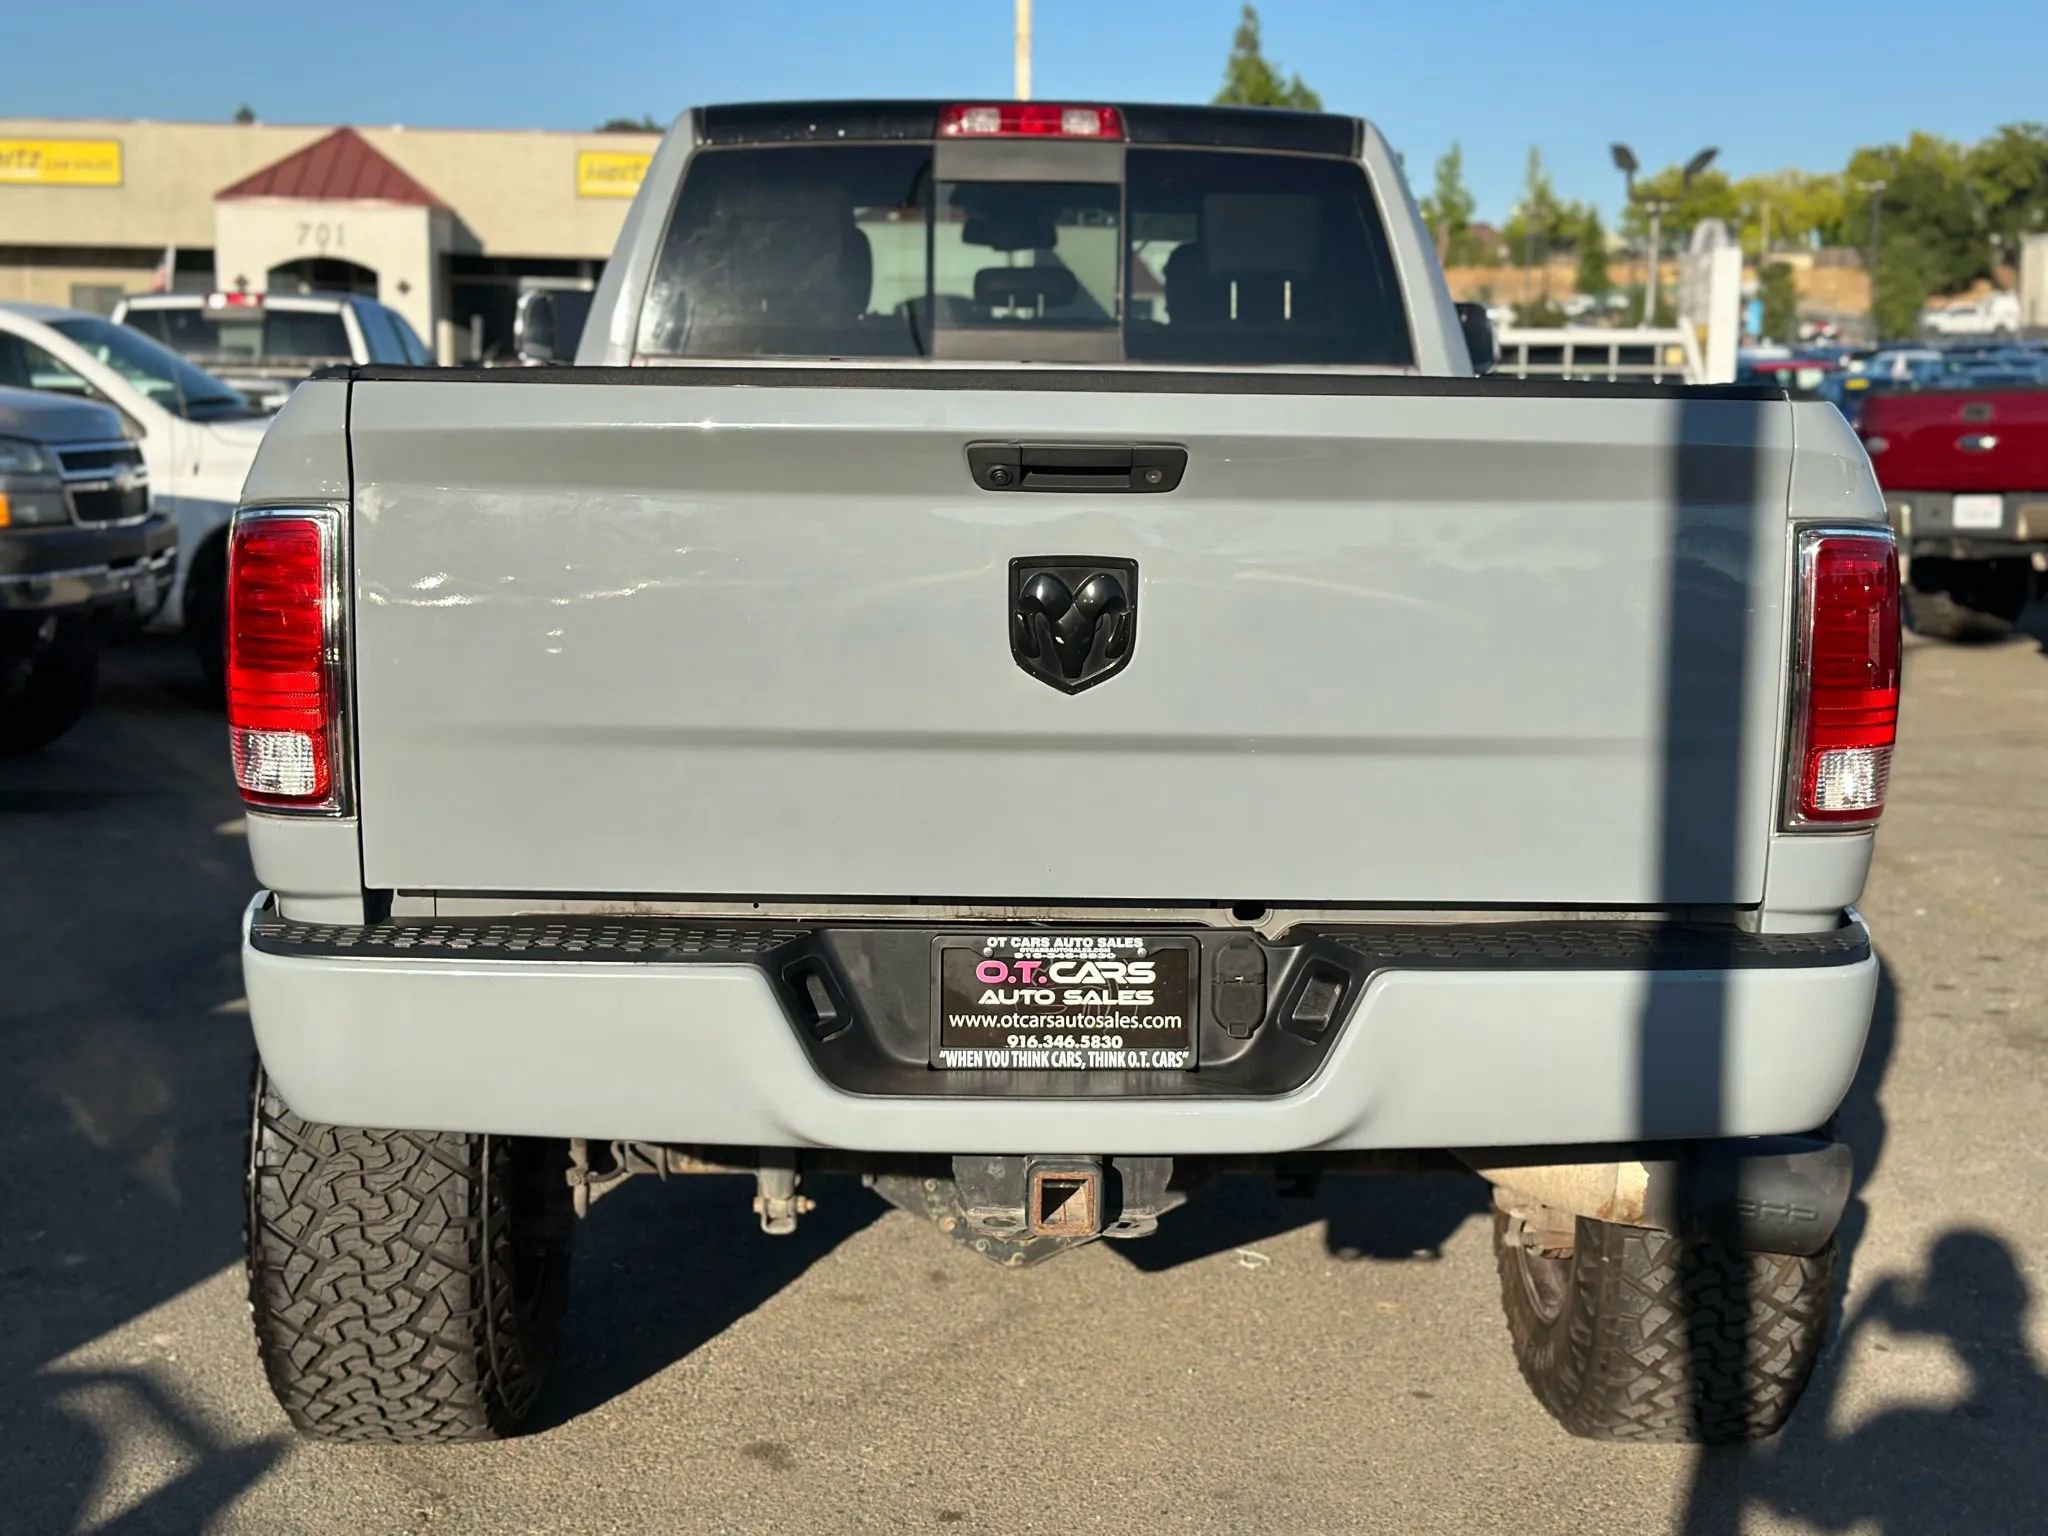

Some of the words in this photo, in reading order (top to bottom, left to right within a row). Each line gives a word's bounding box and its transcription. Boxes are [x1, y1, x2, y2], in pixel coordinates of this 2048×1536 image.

[586, 162, 647, 182] Hert
[296, 221, 345, 248] 701
[987, 937, 1007, 948] OT
[1010, 937, 1050, 948] CARS
[1053, 937, 1094, 948] AUTO
[1097, 937, 1144, 948] SALES
[977, 989, 1056, 1005] AUTO
[1062, 989, 1154, 1005] SALES
[949, 1011, 1182, 1029] www.otcarsautosales.com
[1006, 1034, 1123, 1049] 916.346.5830
[985, 1051, 1010, 1067] YOU
[1011, 1051, 1050, 1067] THINK
[1051, 1051, 1086, 1069] CARS,
[1088, 1051, 1126, 1067] THINK
[1128, 1051, 1150, 1067] O.T.
